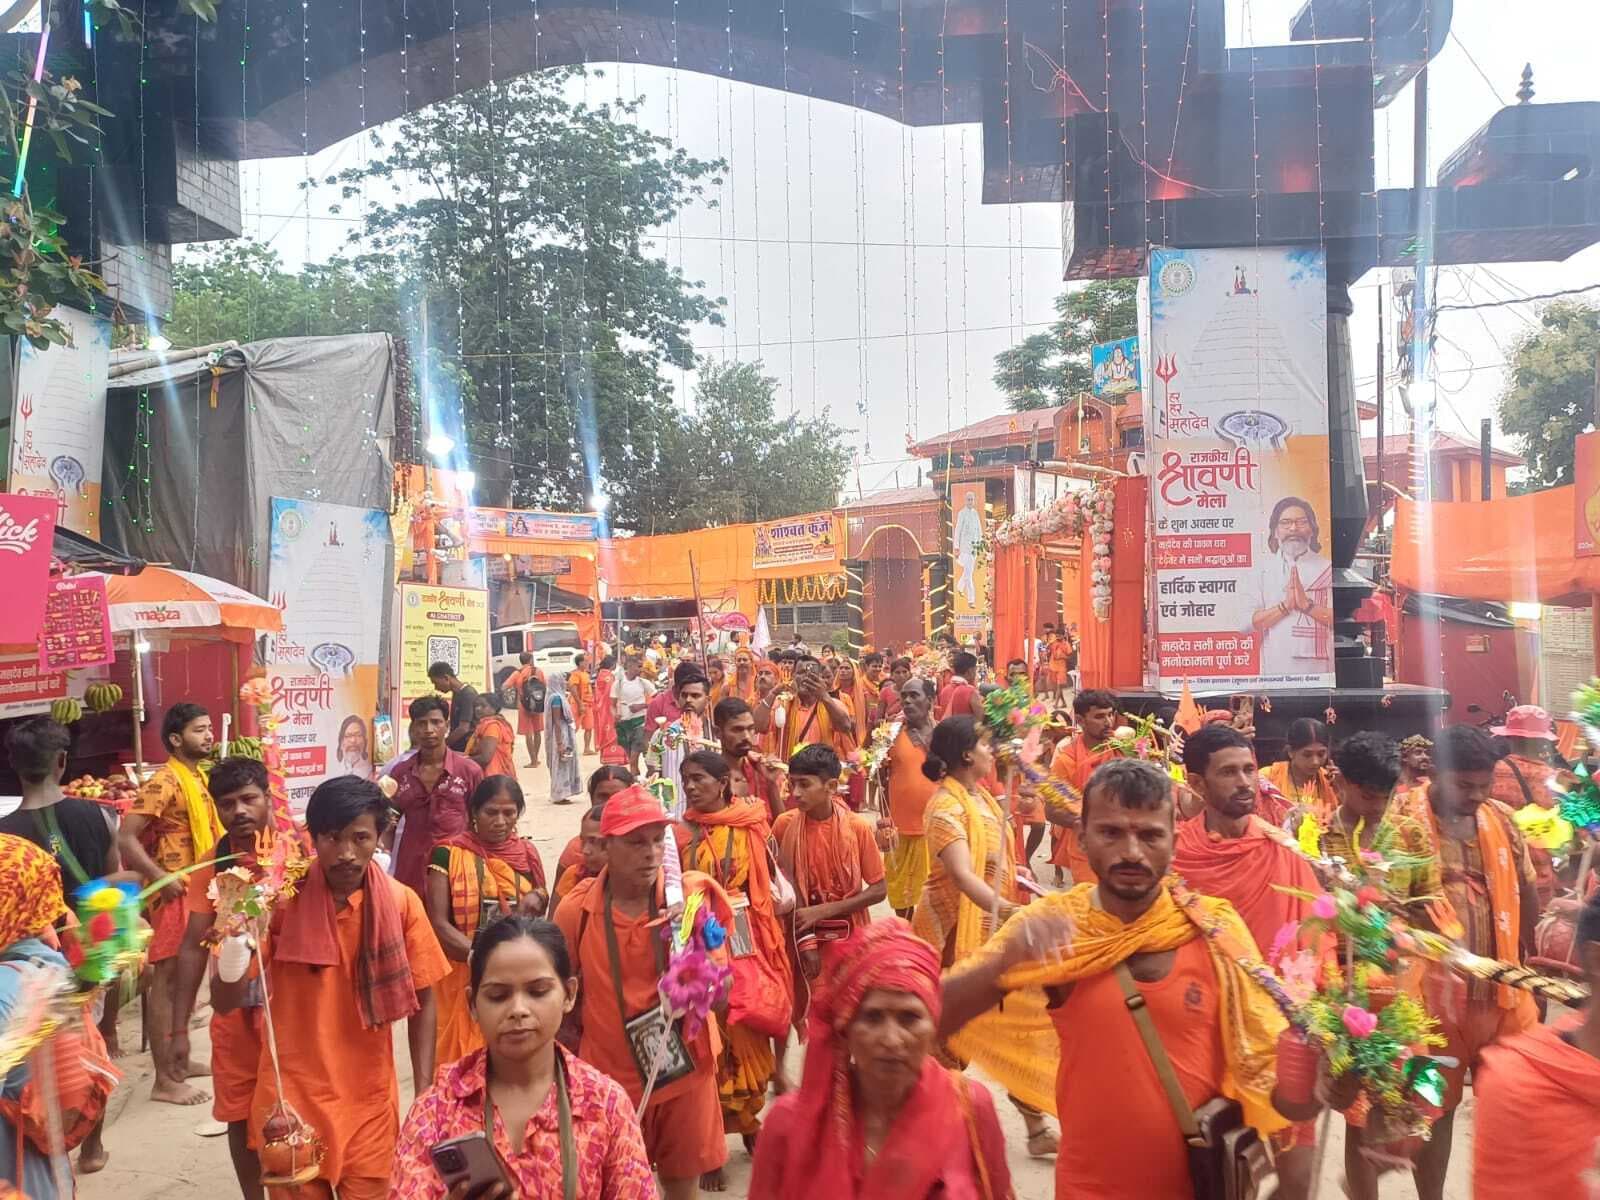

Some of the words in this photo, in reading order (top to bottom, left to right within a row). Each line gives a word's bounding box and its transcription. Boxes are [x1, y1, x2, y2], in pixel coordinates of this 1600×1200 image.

[1169, 411, 1208, 437] महादेव
[1190, 449, 1229, 463] राजकीय
[1157, 447, 1258, 506] श्रावणी
[1196, 490, 1228, 508] मेला
[0, 506, 39, 543] ick
[1171, 519, 1188, 532] शुभ
[1190, 518, 1220, 529] अवसर
[1222, 518, 1234, 528] पर
[1160, 576, 1197, 594] हार्दिक
[1197, 580, 1237, 594] स्वागत
[1160, 601, 1178, 617] एवं
[1180, 600, 1216, 617] जोहार
[1193, 638, 1213, 651] सभी
[1240, 636, 1253, 650] की
[1161, 655, 1214, 668] मनोकामना
[1216, 653, 1232, 669] पूर्ण
